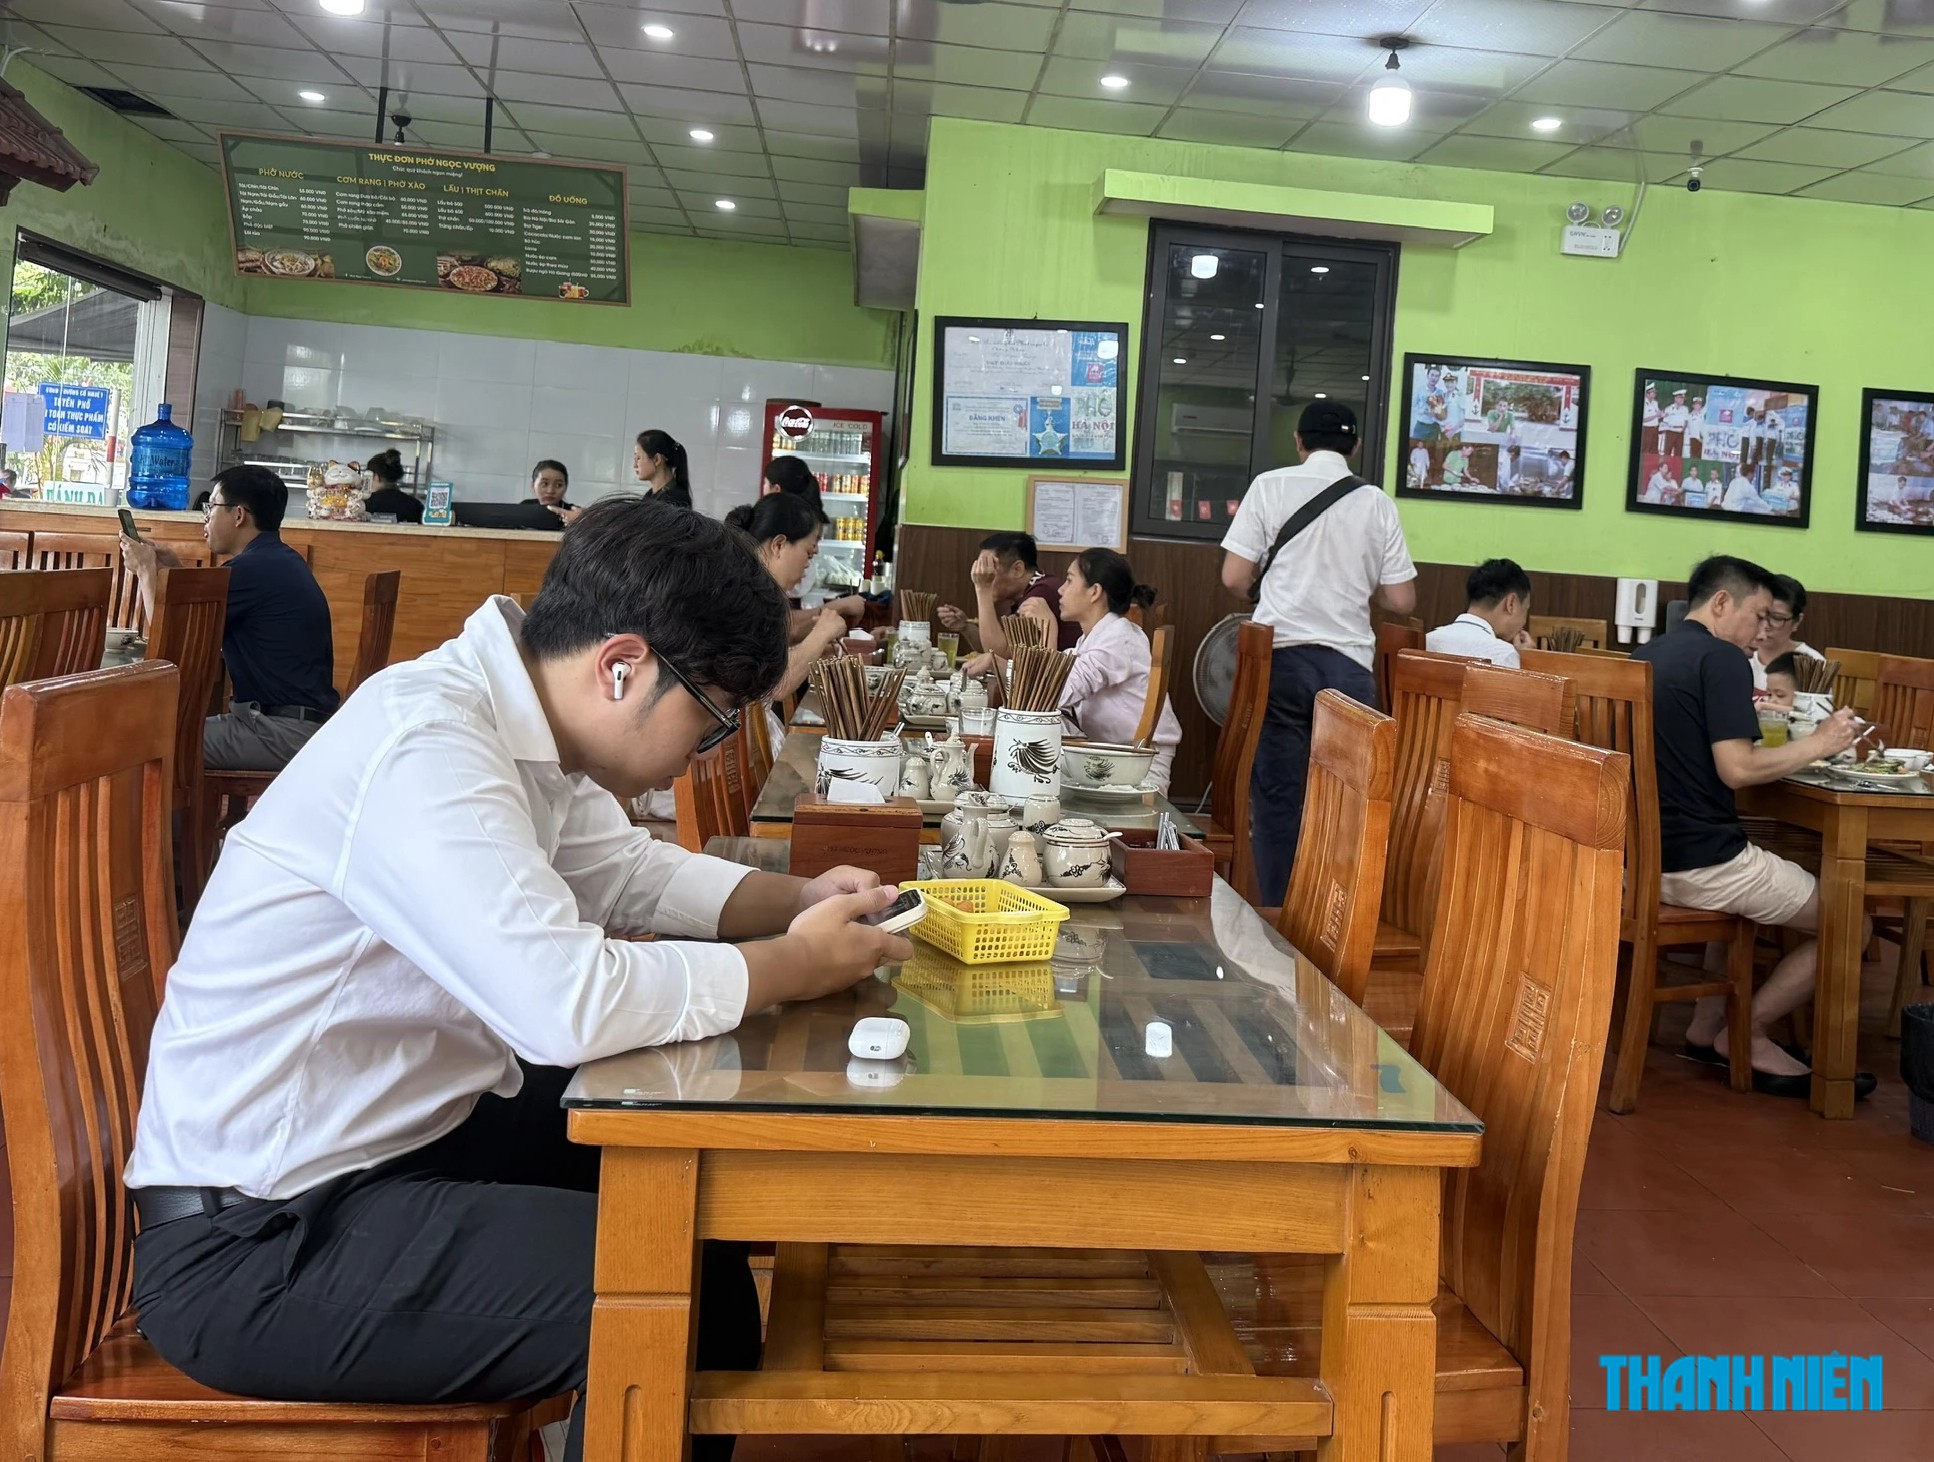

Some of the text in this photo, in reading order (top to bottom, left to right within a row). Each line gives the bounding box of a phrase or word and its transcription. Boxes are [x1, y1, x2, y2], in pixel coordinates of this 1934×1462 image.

[368, 153, 496, 173] THỰC ĐƠN PHỞ NGỌC VƯỢNG
[259, 167, 304, 179] PHỞ NƯỚC
[336, 176, 426, 190] CƠM RANG PHỞ XÀO
[466, 187, 483, 196] THỊT
[67, 411, 83, 422] THỰC
[47, 421, 57, 431] CÓ
